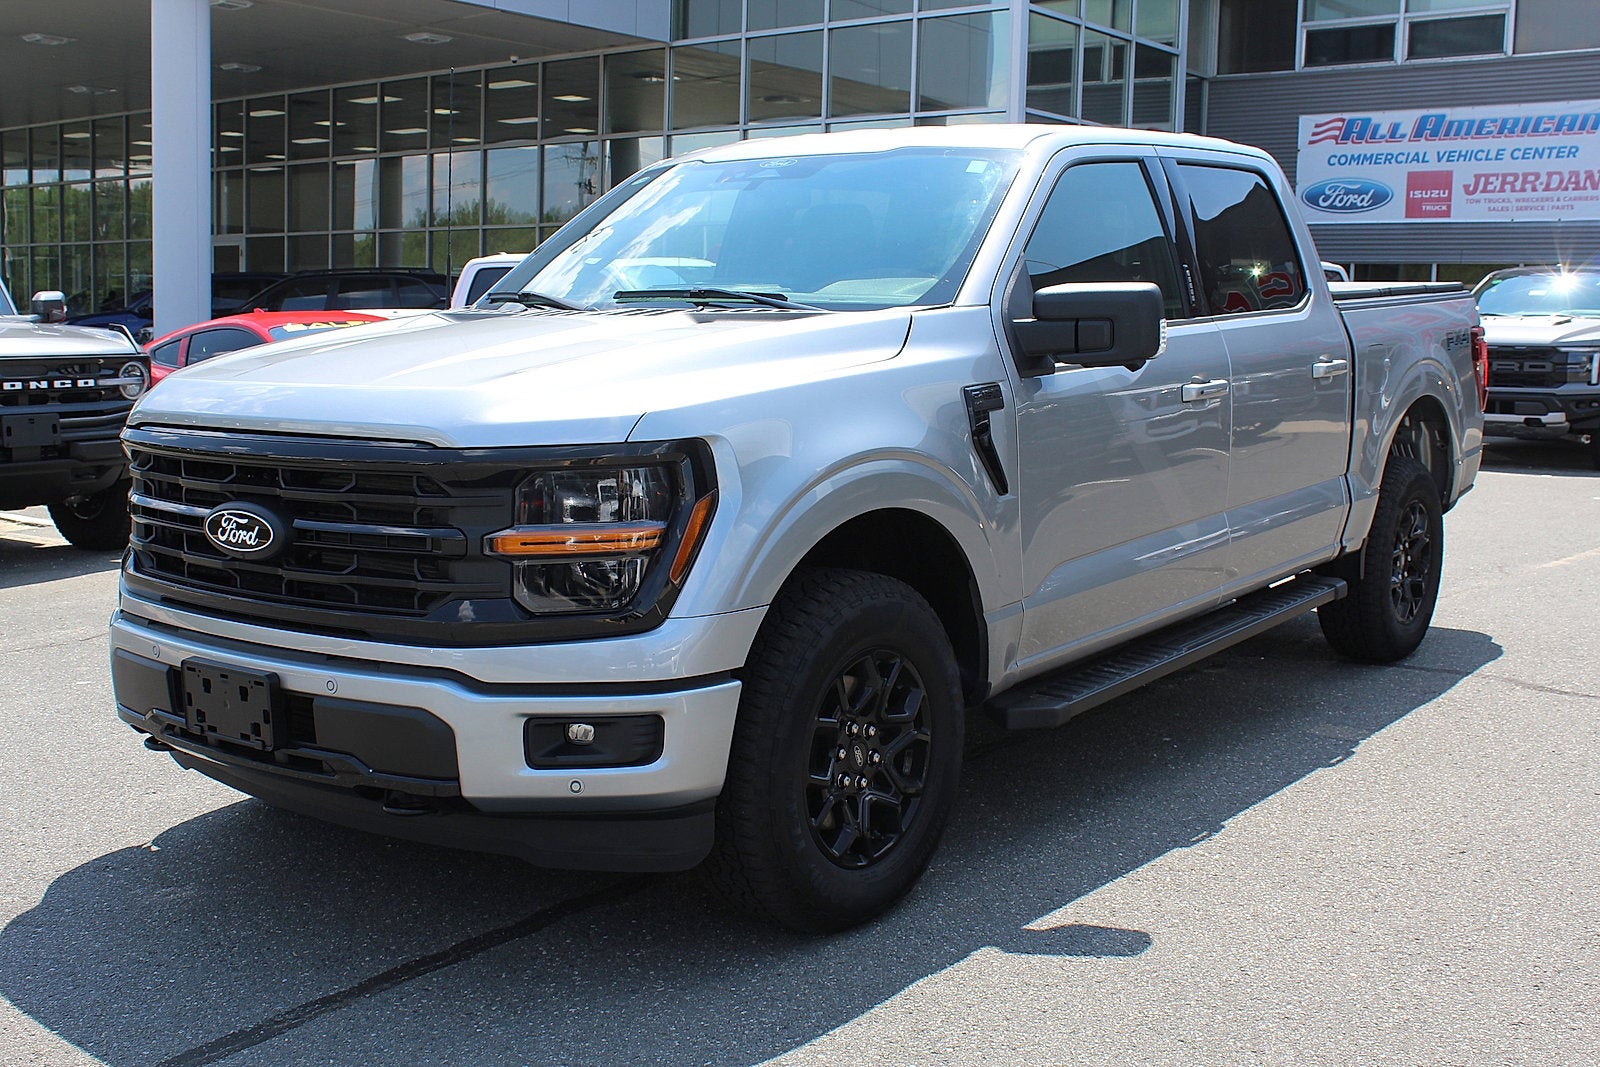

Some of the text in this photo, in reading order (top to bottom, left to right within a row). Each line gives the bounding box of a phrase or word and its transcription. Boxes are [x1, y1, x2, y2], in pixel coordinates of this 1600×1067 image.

[1337, 112, 1600, 145] ALL AMERICAN
[1327, 145, 1580, 167] COMMERCIAL VEHICLE CENTER
[1318, 182, 1376, 208] Ford
[1409, 189, 1449, 199] ISUZU
[1562, 195, 1599, 203] CARRIERS
[1421, 204, 1448, 212] TRUCK
[1488, 203, 1575, 213] SALES SERVICE PARTS
[2, 379, 96, 391] ONCO
[217, 514, 260, 546] Ford
